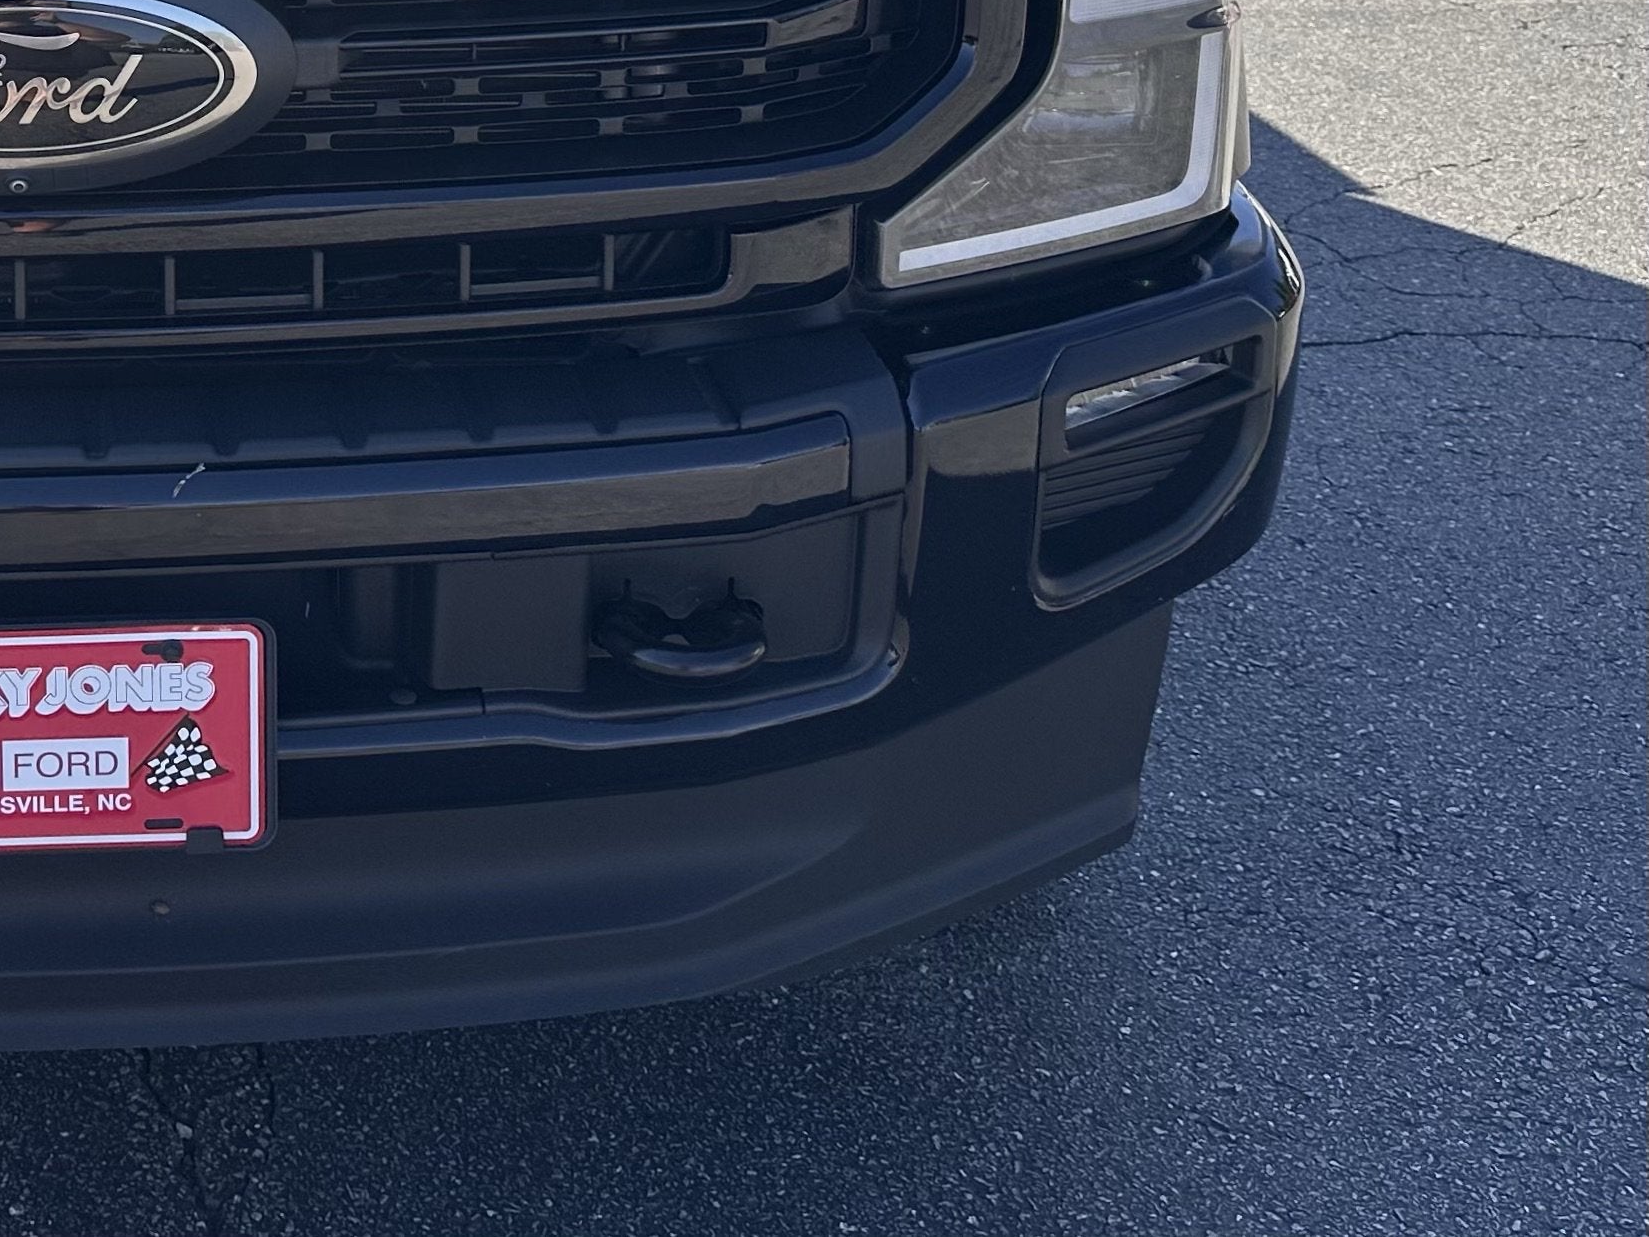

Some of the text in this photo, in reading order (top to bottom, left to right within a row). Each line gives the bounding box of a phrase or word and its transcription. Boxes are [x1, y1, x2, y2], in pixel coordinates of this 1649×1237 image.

[34, 661, 216, 715] JONES
[13, 750, 119, 779] FORD
[97, 793, 133, 812] NC
